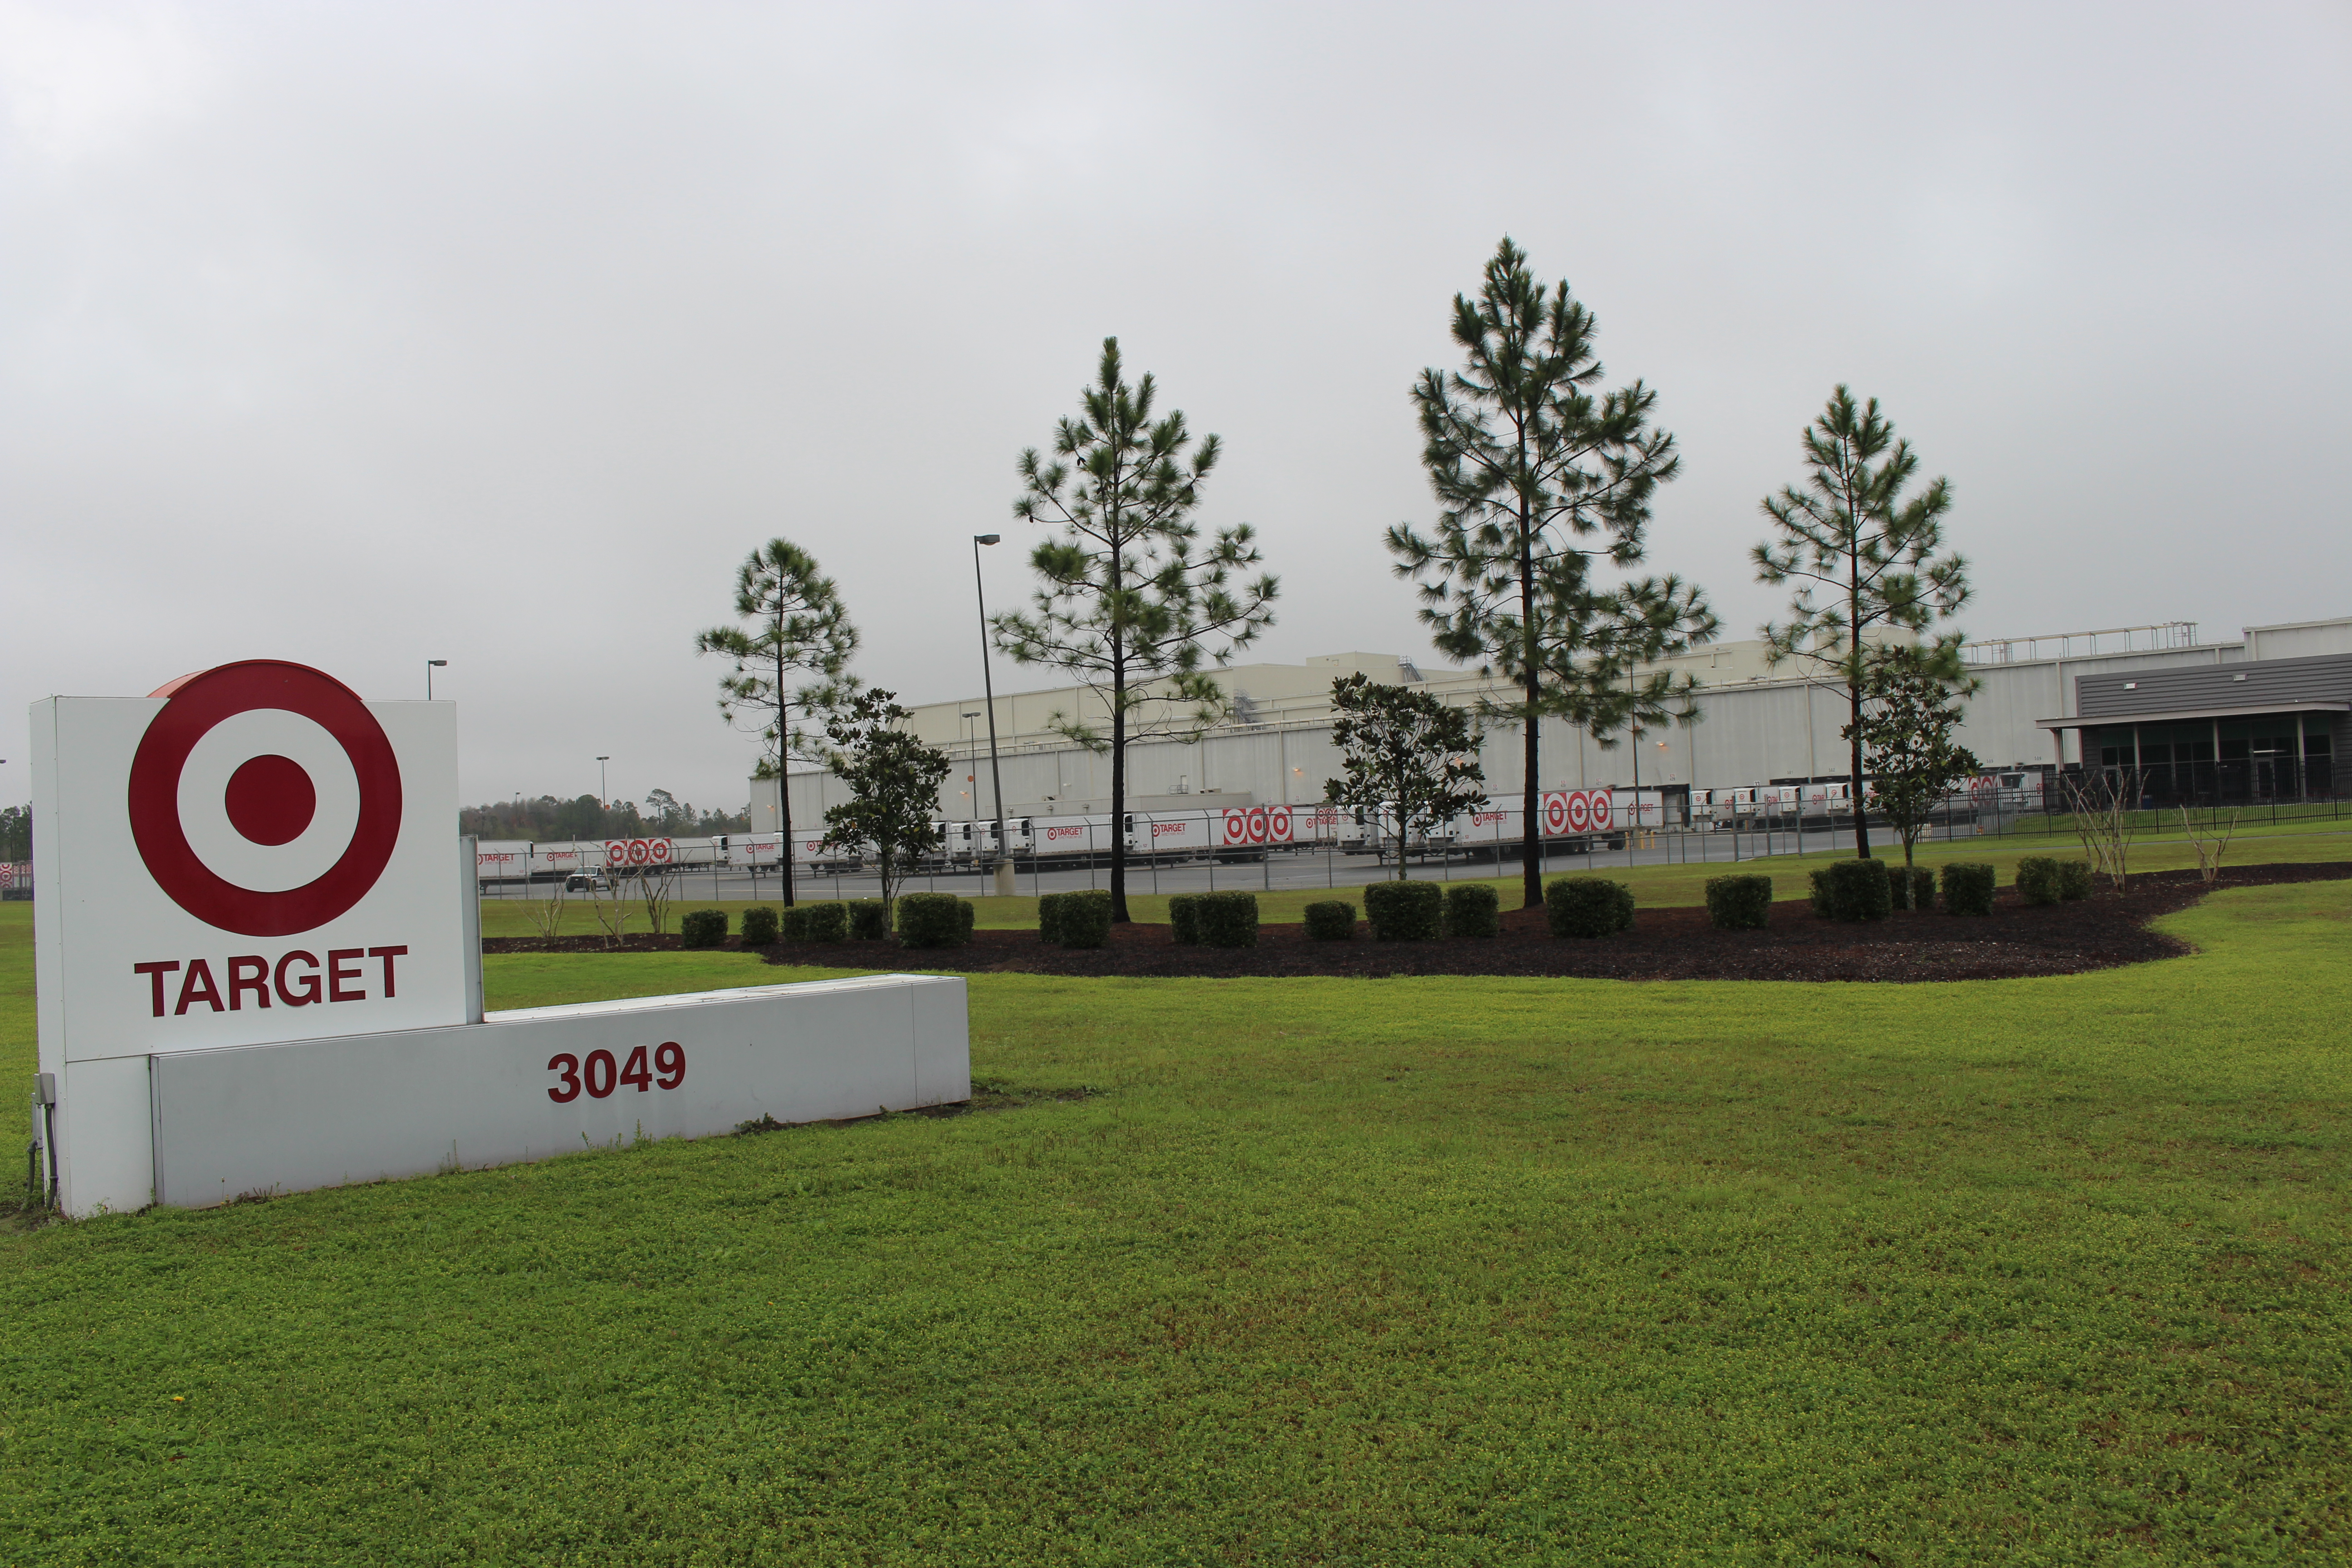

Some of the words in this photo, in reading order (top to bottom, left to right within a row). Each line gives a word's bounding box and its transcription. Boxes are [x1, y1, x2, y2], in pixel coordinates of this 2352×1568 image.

[1482, 810, 1507, 821] TARGET
[1057, 827, 1083, 836] TARGET
[1160, 823, 1186, 833] TARGET
[484, 853, 514, 862] TARGET
[134, 945, 408, 1017] TARGET
[548, 1041, 686, 1103] 3049
